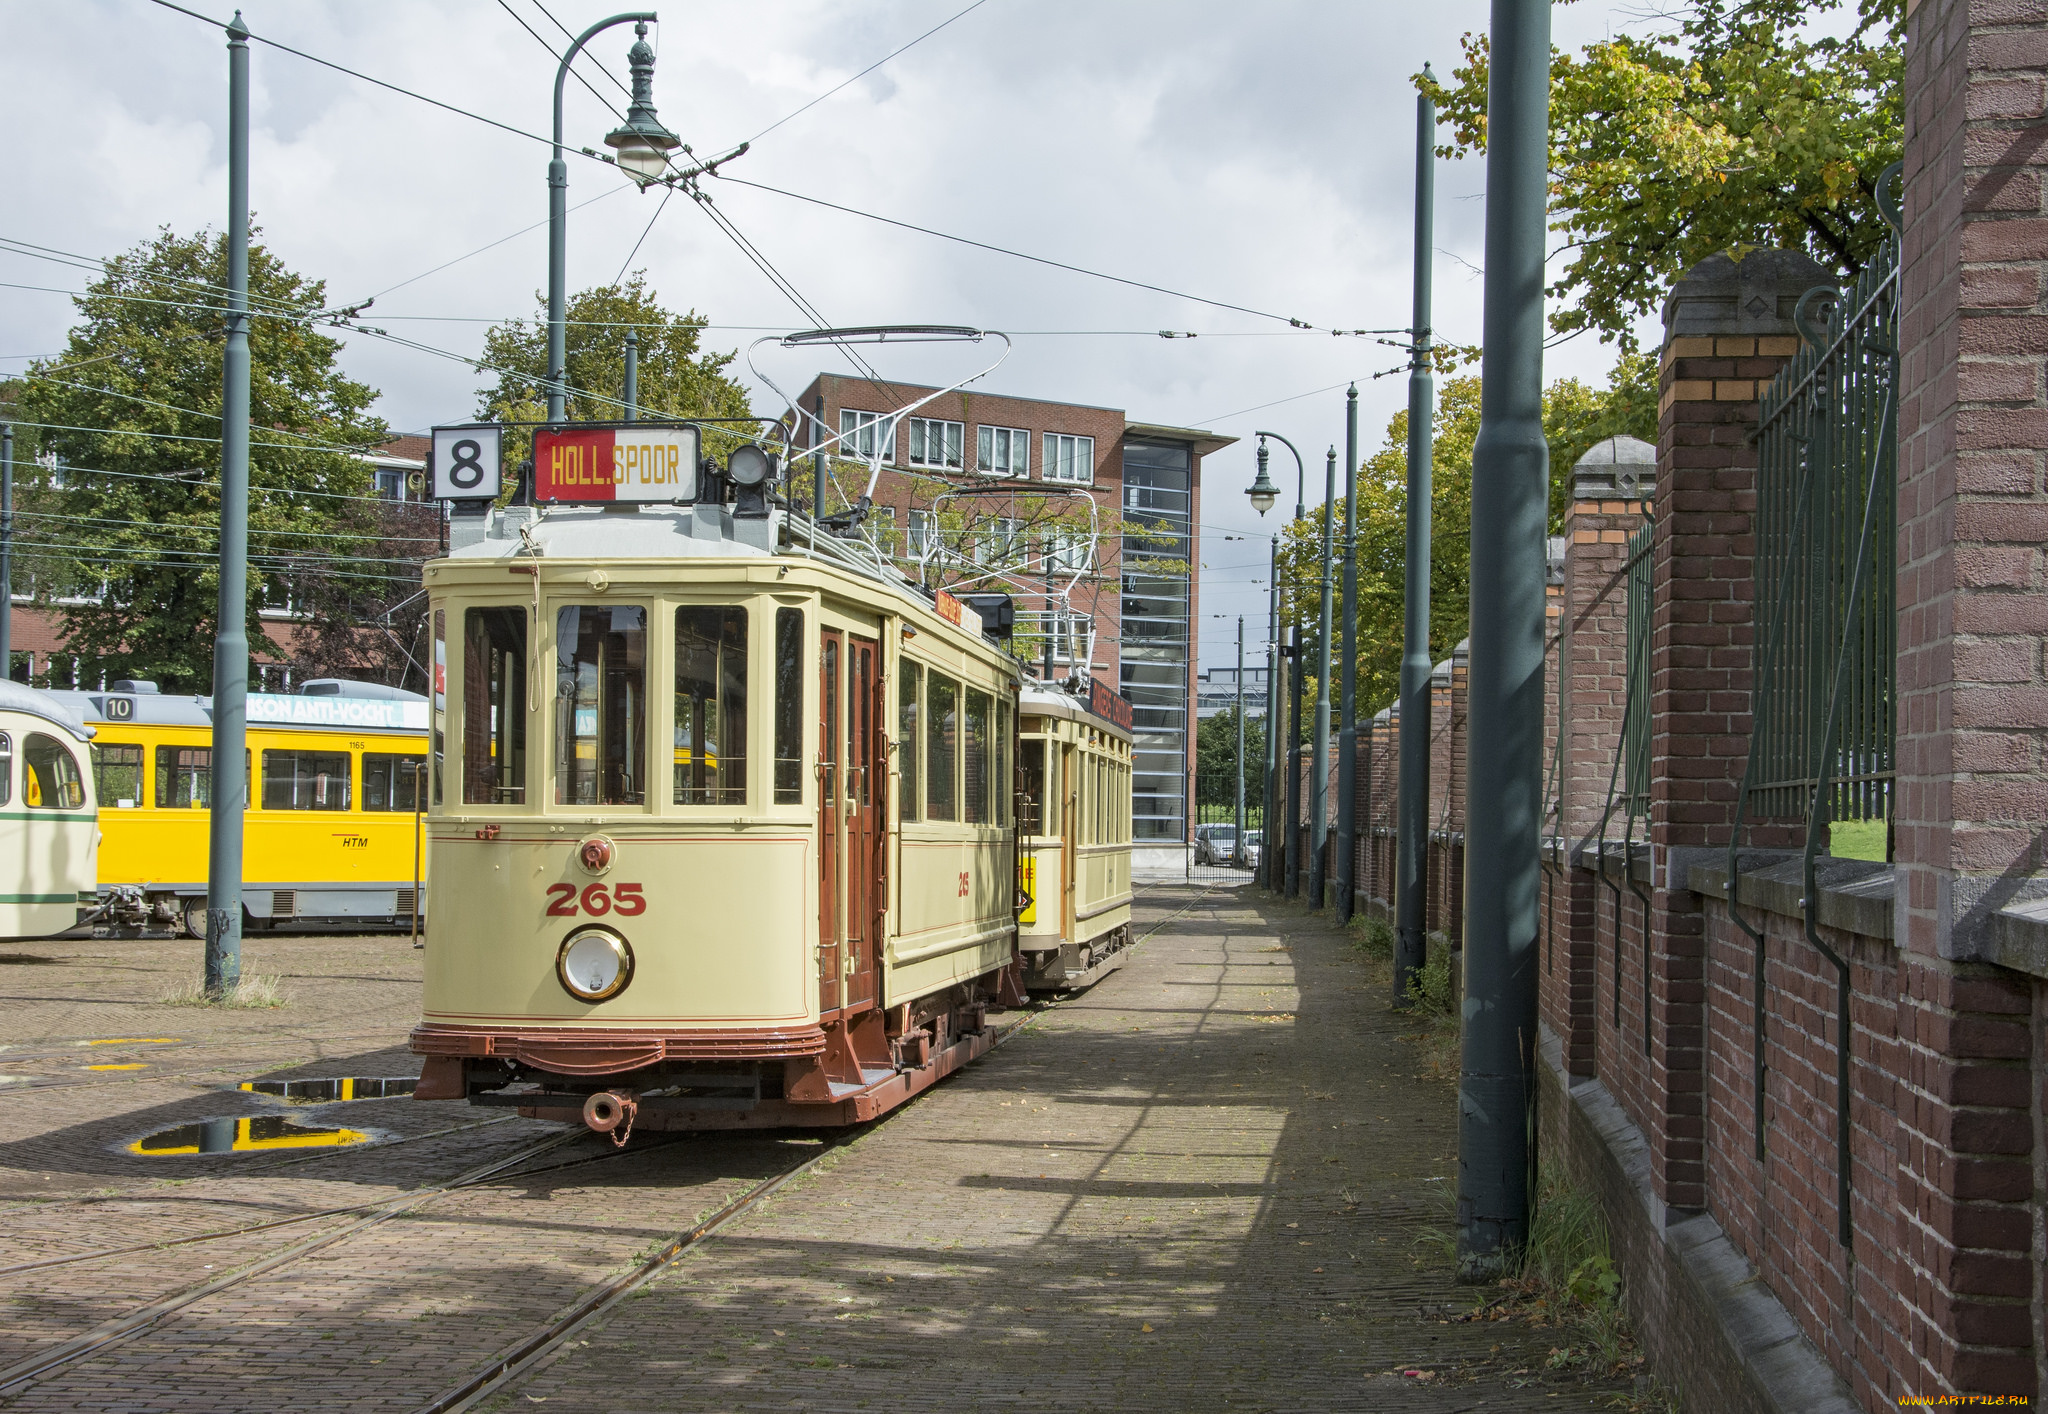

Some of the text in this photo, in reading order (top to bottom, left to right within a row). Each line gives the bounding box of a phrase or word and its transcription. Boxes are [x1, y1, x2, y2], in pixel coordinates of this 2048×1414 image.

[450, 440, 484, 489] 8
[109, 699, 129, 716] 10
[247, 698, 393, 722] ISON ANTI-VOCHT
[349, 741, 365, 749] 1165
[343, 837, 368, 847] HTM
[546, 882, 647, 917] 265
